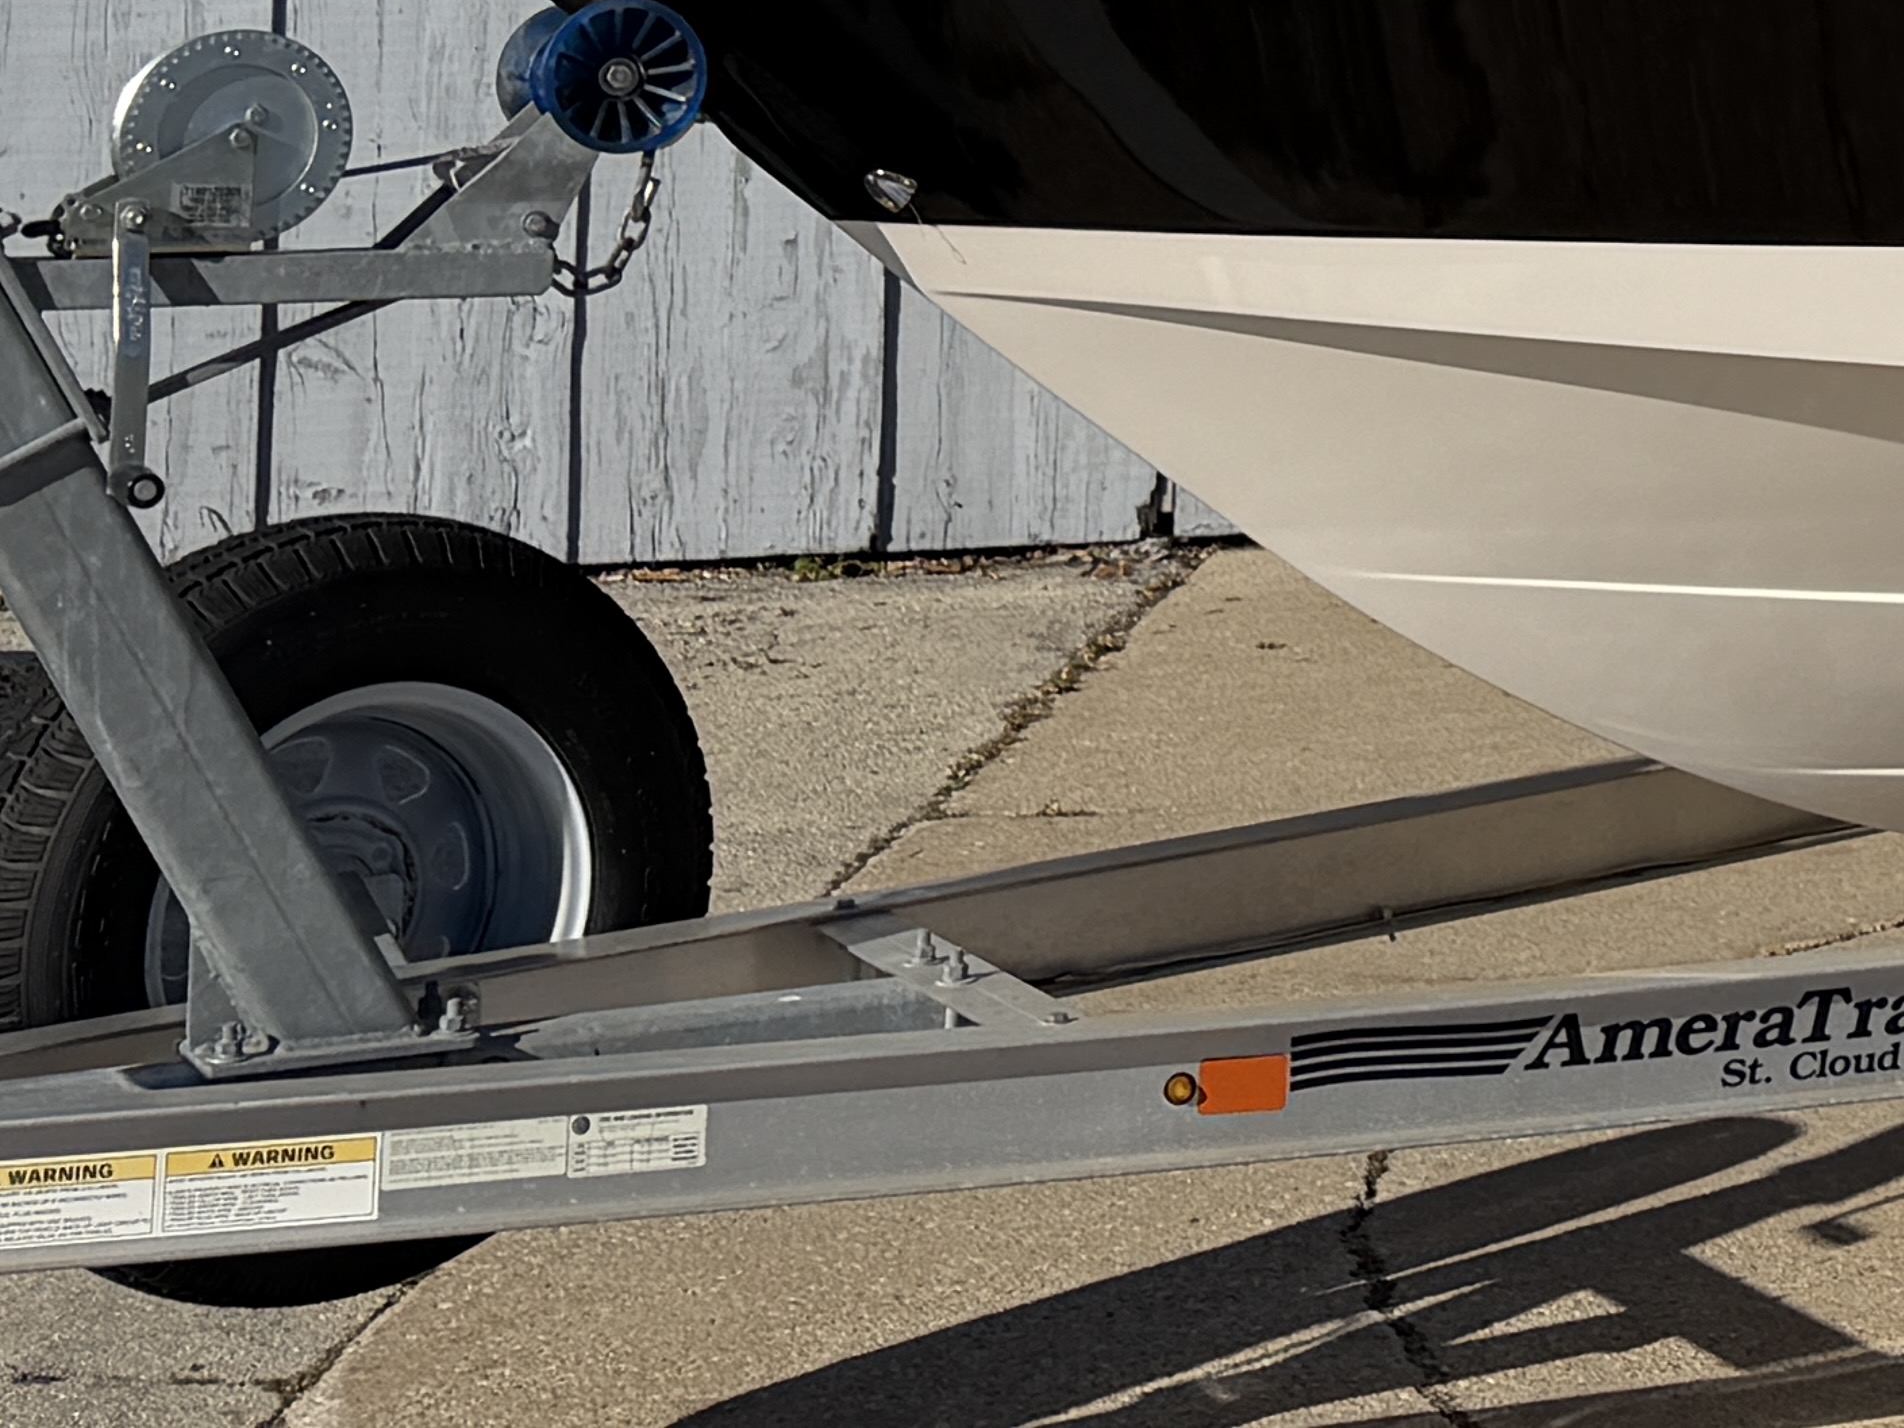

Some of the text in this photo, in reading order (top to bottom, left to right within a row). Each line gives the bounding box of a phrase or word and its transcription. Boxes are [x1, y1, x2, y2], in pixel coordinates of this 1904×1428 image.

[1721, 1057, 1773, 1088] St.
[1789, 1041, 1902, 1081] Cloud
[233, 1145, 335, 1166] WARNING
[8, 1163, 114, 1185] WARNING
